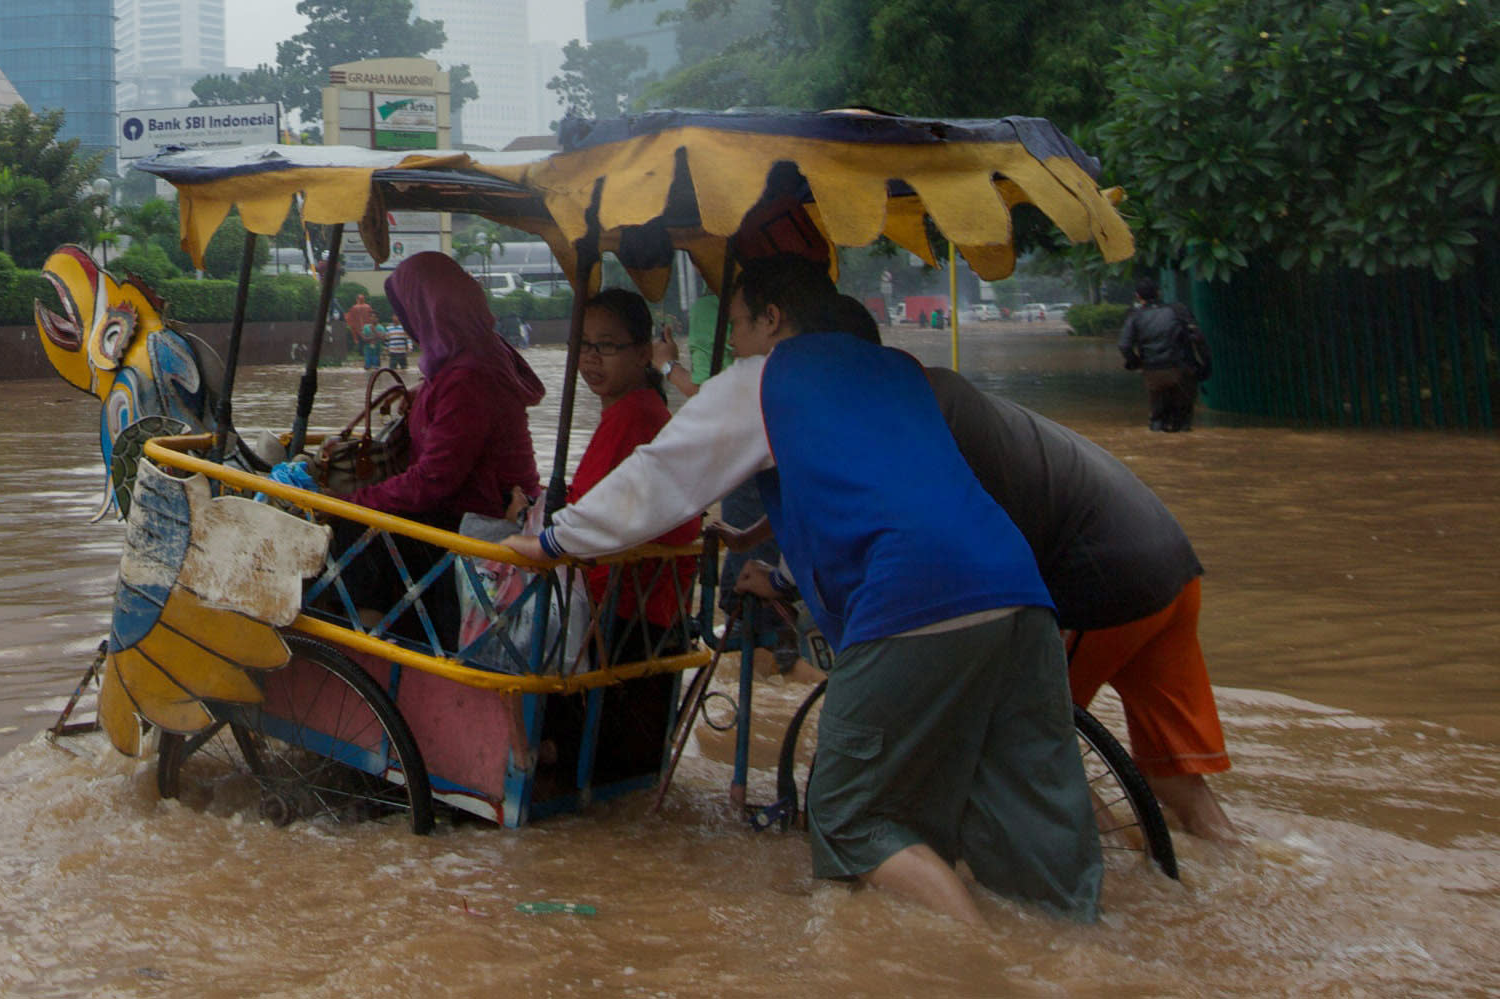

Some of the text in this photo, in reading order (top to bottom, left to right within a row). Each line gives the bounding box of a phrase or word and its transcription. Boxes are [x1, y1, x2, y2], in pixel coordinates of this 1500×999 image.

[348, 72, 434, 88] GRAHA MANDIRI
[148, 112, 275, 132] Bank SBI Indonesia
